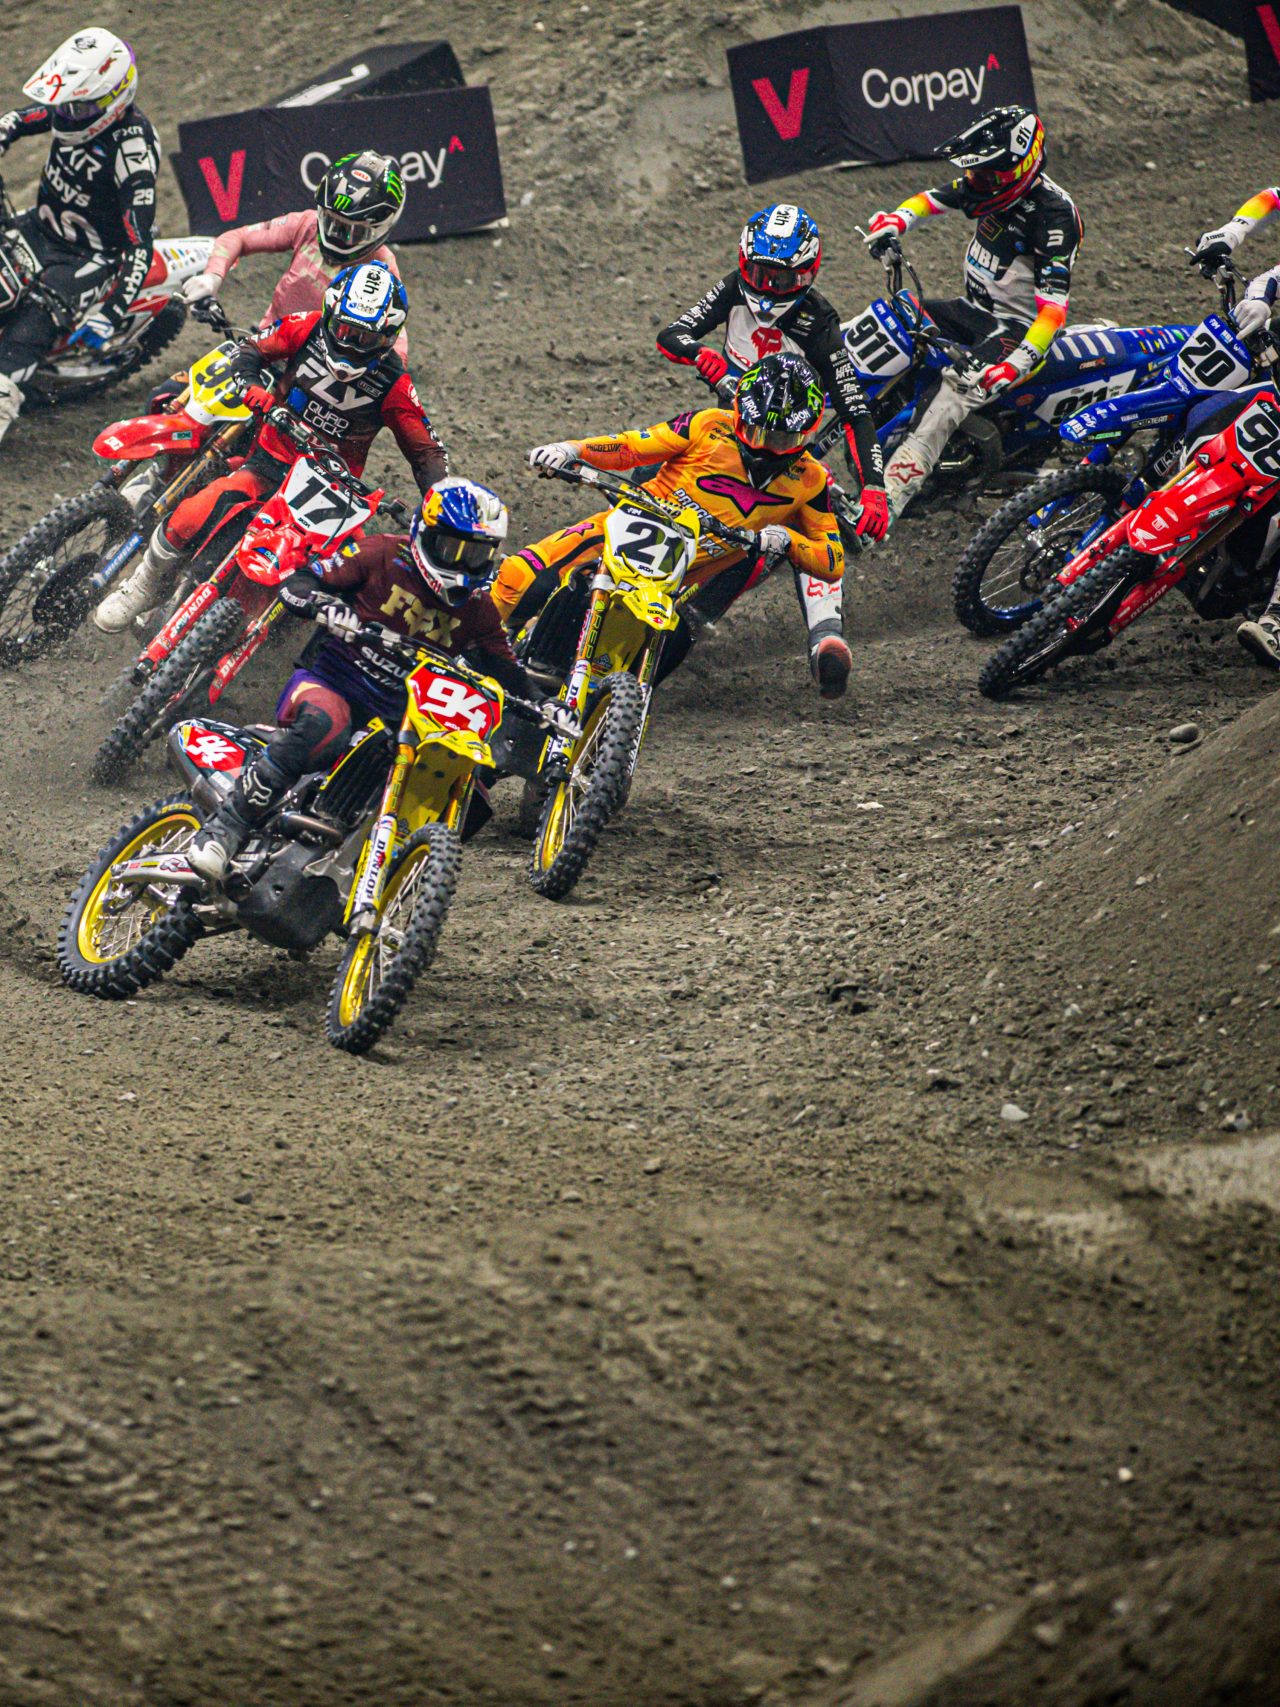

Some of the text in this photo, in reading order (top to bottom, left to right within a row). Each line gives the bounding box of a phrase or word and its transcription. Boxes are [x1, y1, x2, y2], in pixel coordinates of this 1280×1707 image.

[861, 64, 986, 112] Corpay
[112, 125, 144, 142] FXR
[132, 188, 155, 206] 29
[752, 254, 787, 266] HONDA
[341, 314, 373, 330] HONDA
[845, 314, 900, 374] 911
[1178, 332, 1236, 388] 20
[295, 357, 376, 412] FLY
[302, 409, 346, 439] LOCK
[307, 400, 350, 431] QUAD
[288, 475, 359, 526] 17
[104, 534, 141, 580] MICHELIN
[614, 520, 683, 573] 21
[360, 646, 408, 679] SUZU
[419, 677, 488, 733] 94
[366, 839, 386, 901] DUNLOP
